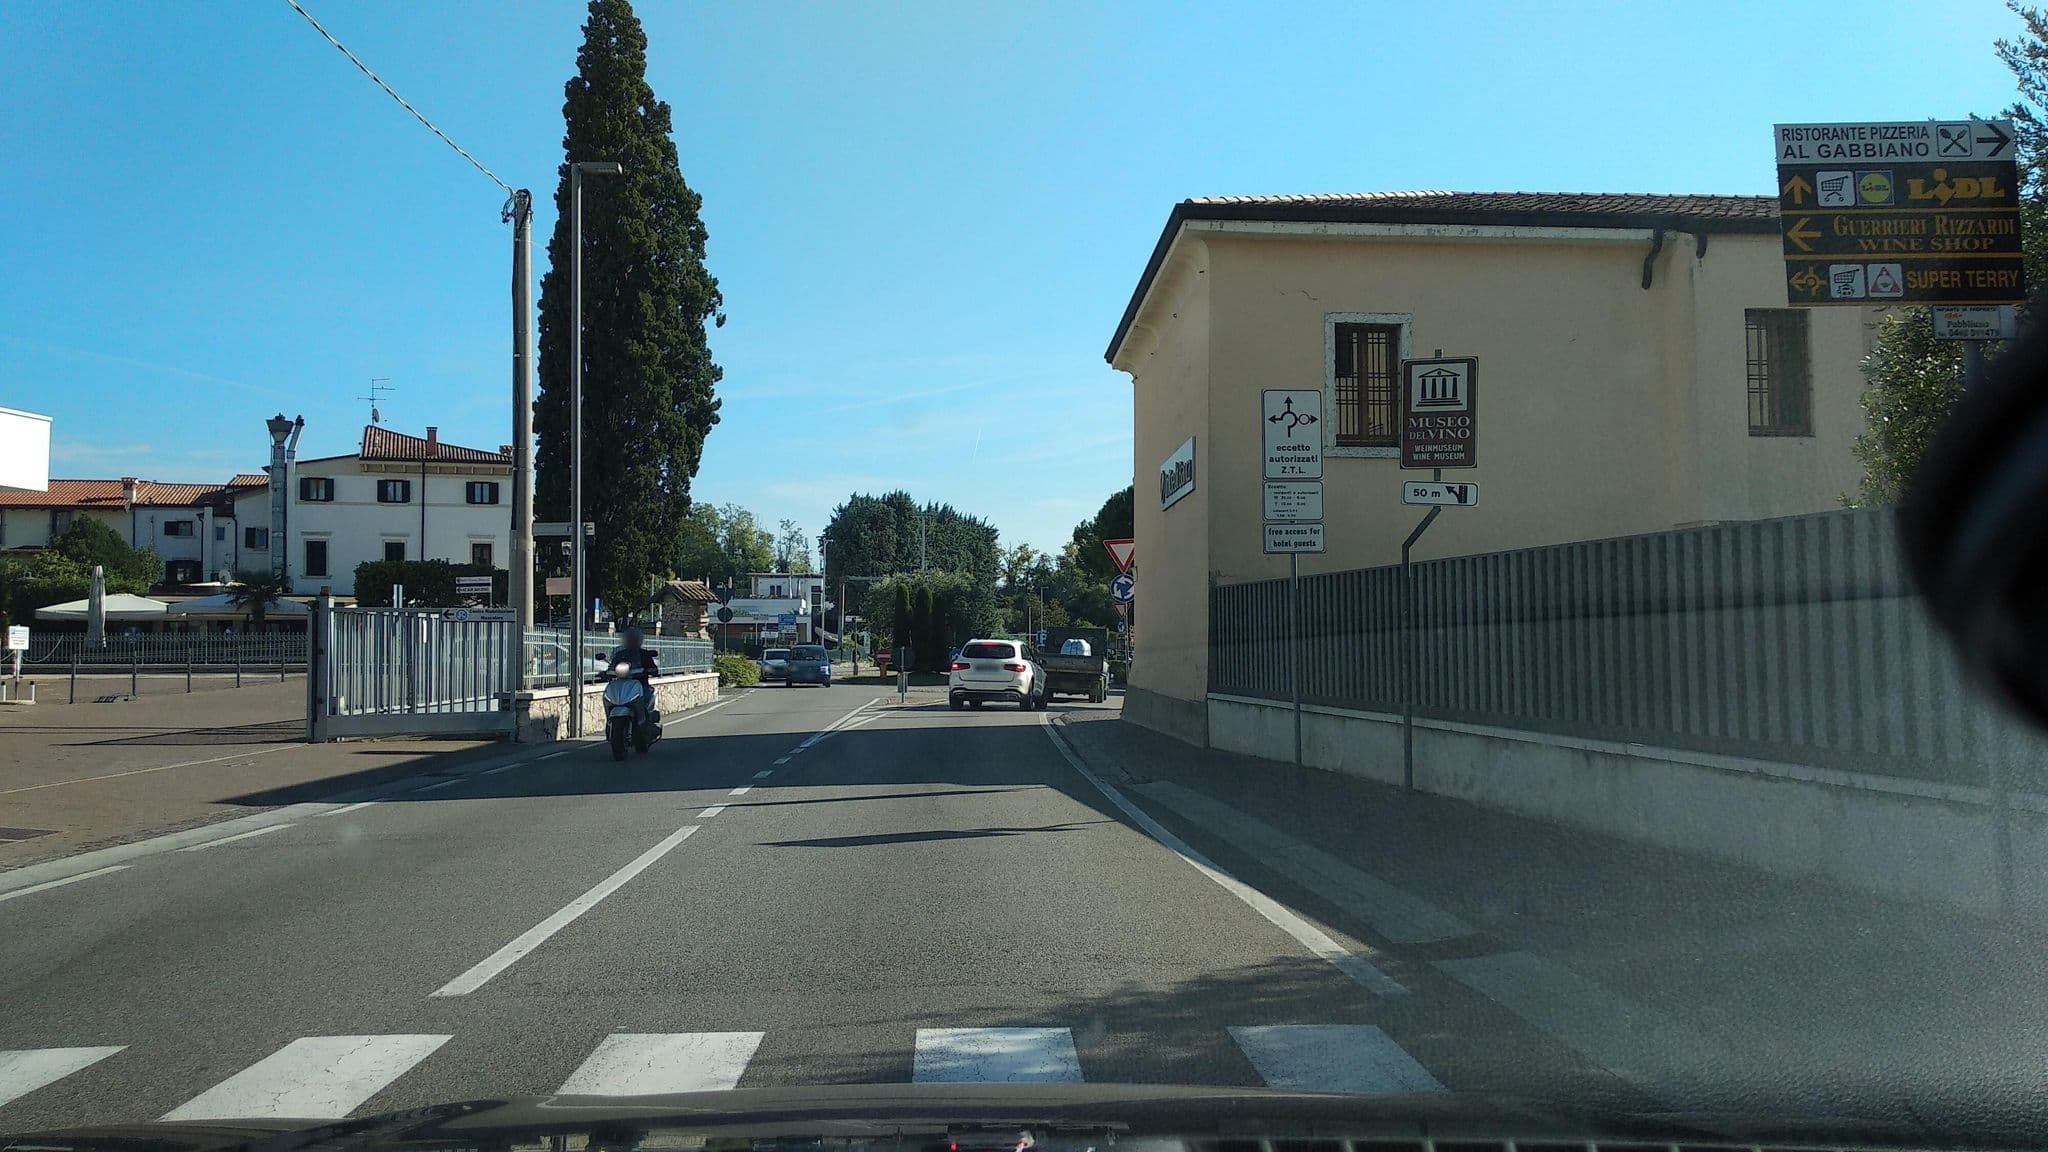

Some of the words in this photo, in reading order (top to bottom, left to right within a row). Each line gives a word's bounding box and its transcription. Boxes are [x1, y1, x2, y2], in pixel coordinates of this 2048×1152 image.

[1782, 126, 1866, 141] RISTORANTE
[1870, 126, 1930, 140] PIZZERIA
[1783, 143, 1810, 159] AL
[1817, 142, 1929, 158] GABBIANO
[1833, 215, 1926, 237] GUERRIERI
[1935, 214, 2015, 236] RIZZARDI
[1858, 238, 1924, 251] WINE
[1931, 237, 1995, 250] SHOP
[1906, 271, 1961, 289] SUPER
[1966, 270, 2019, 288] TERRY
[1408, 416, 1470, 429] MUSEO
[1427, 427, 1471, 440] VINO
[1276, 443, 1311, 452] eccetto
[1414, 444, 1464, 452] WEINMUSEUM
[1268, 454, 1318, 463] autorizzati
[1412, 452, 1431, 461] WINE
[1434, 452, 1465, 461] MUSEUM
[1281, 466, 1306, 474] Z.T.L.
[1413, 488, 1428, 497] 50
[1431, 490, 1441, 498] m
[1293, 540, 1317, 549] guests
